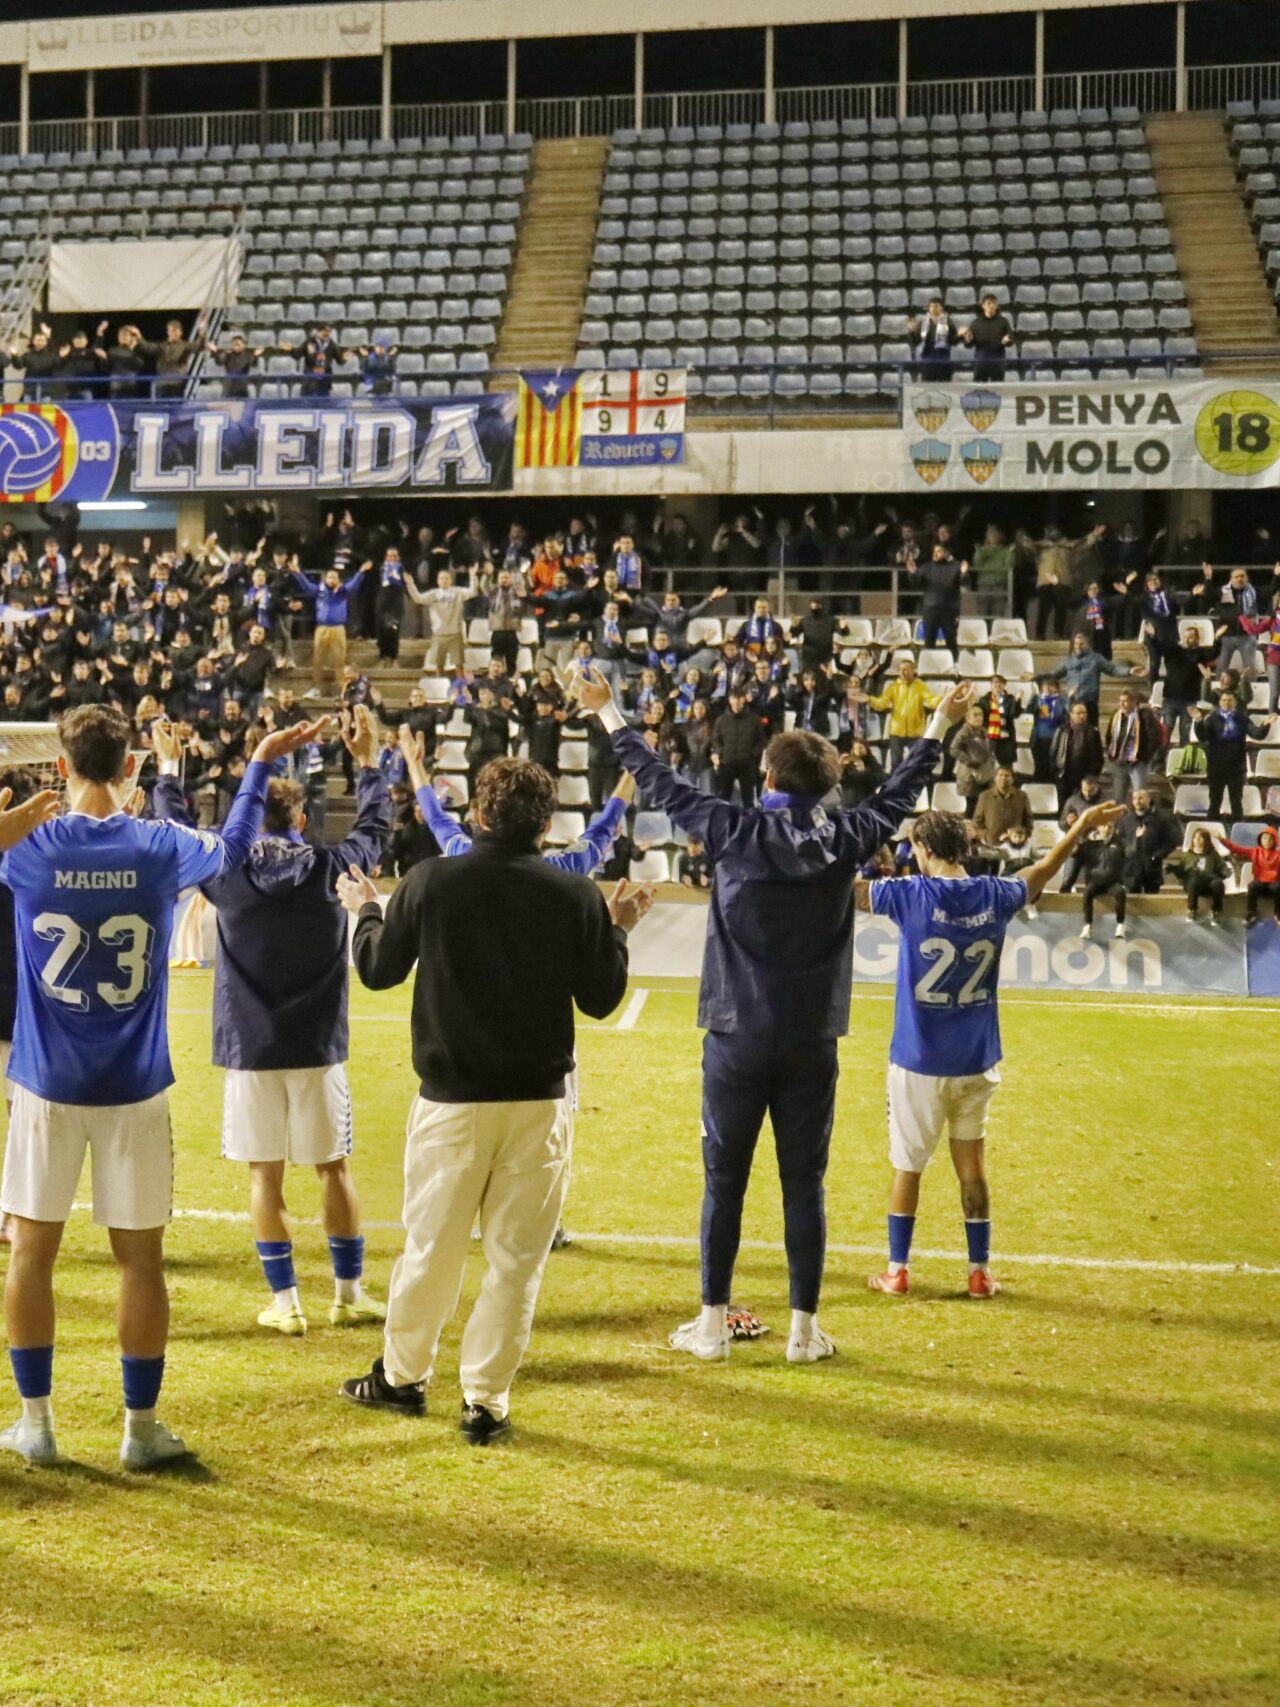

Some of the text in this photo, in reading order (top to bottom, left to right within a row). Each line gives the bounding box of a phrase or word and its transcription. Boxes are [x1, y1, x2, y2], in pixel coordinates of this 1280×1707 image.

[77, 12, 331, 45] LLEIDA ESPORTIU
[600, 372, 669, 397] 1 9
[598, 409, 667, 432] 9 4
[1015, 392, 1182, 426] PENYA
[131, 404, 491, 492] LLEIDA
[1213, 412, 1271, 453] 18
[80, 441, 111, 461] 03
[1026, 439, 1170, 475] MOLO
[54, 870, 137, 889] MAGNO
[32, 912, 156, 1012] 23
[915, 937, 997, 1009] 22
